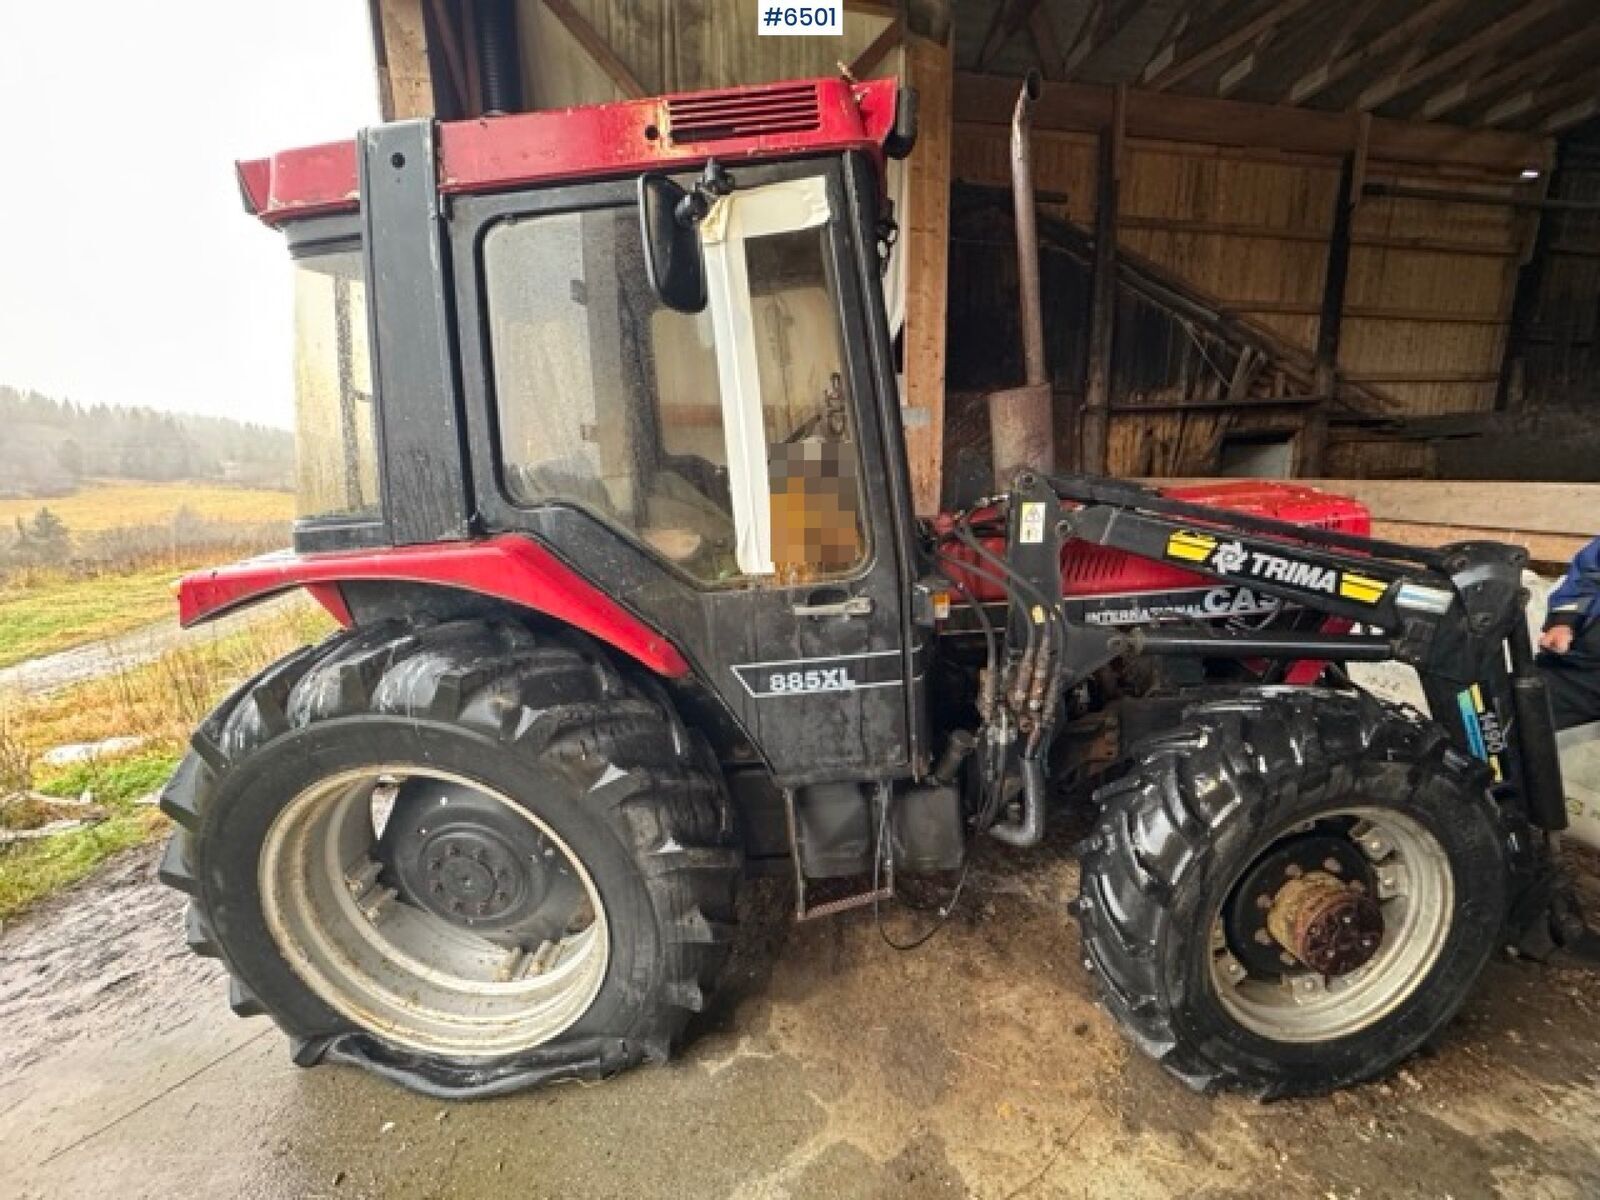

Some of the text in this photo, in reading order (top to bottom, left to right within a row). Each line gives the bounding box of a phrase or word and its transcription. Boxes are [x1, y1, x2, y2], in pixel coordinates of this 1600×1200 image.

[1251, 552, 1336, 593] TRIMA
[1204, 586, 1303, 612] CAS
[769, 667, 856, 691] 885XL
